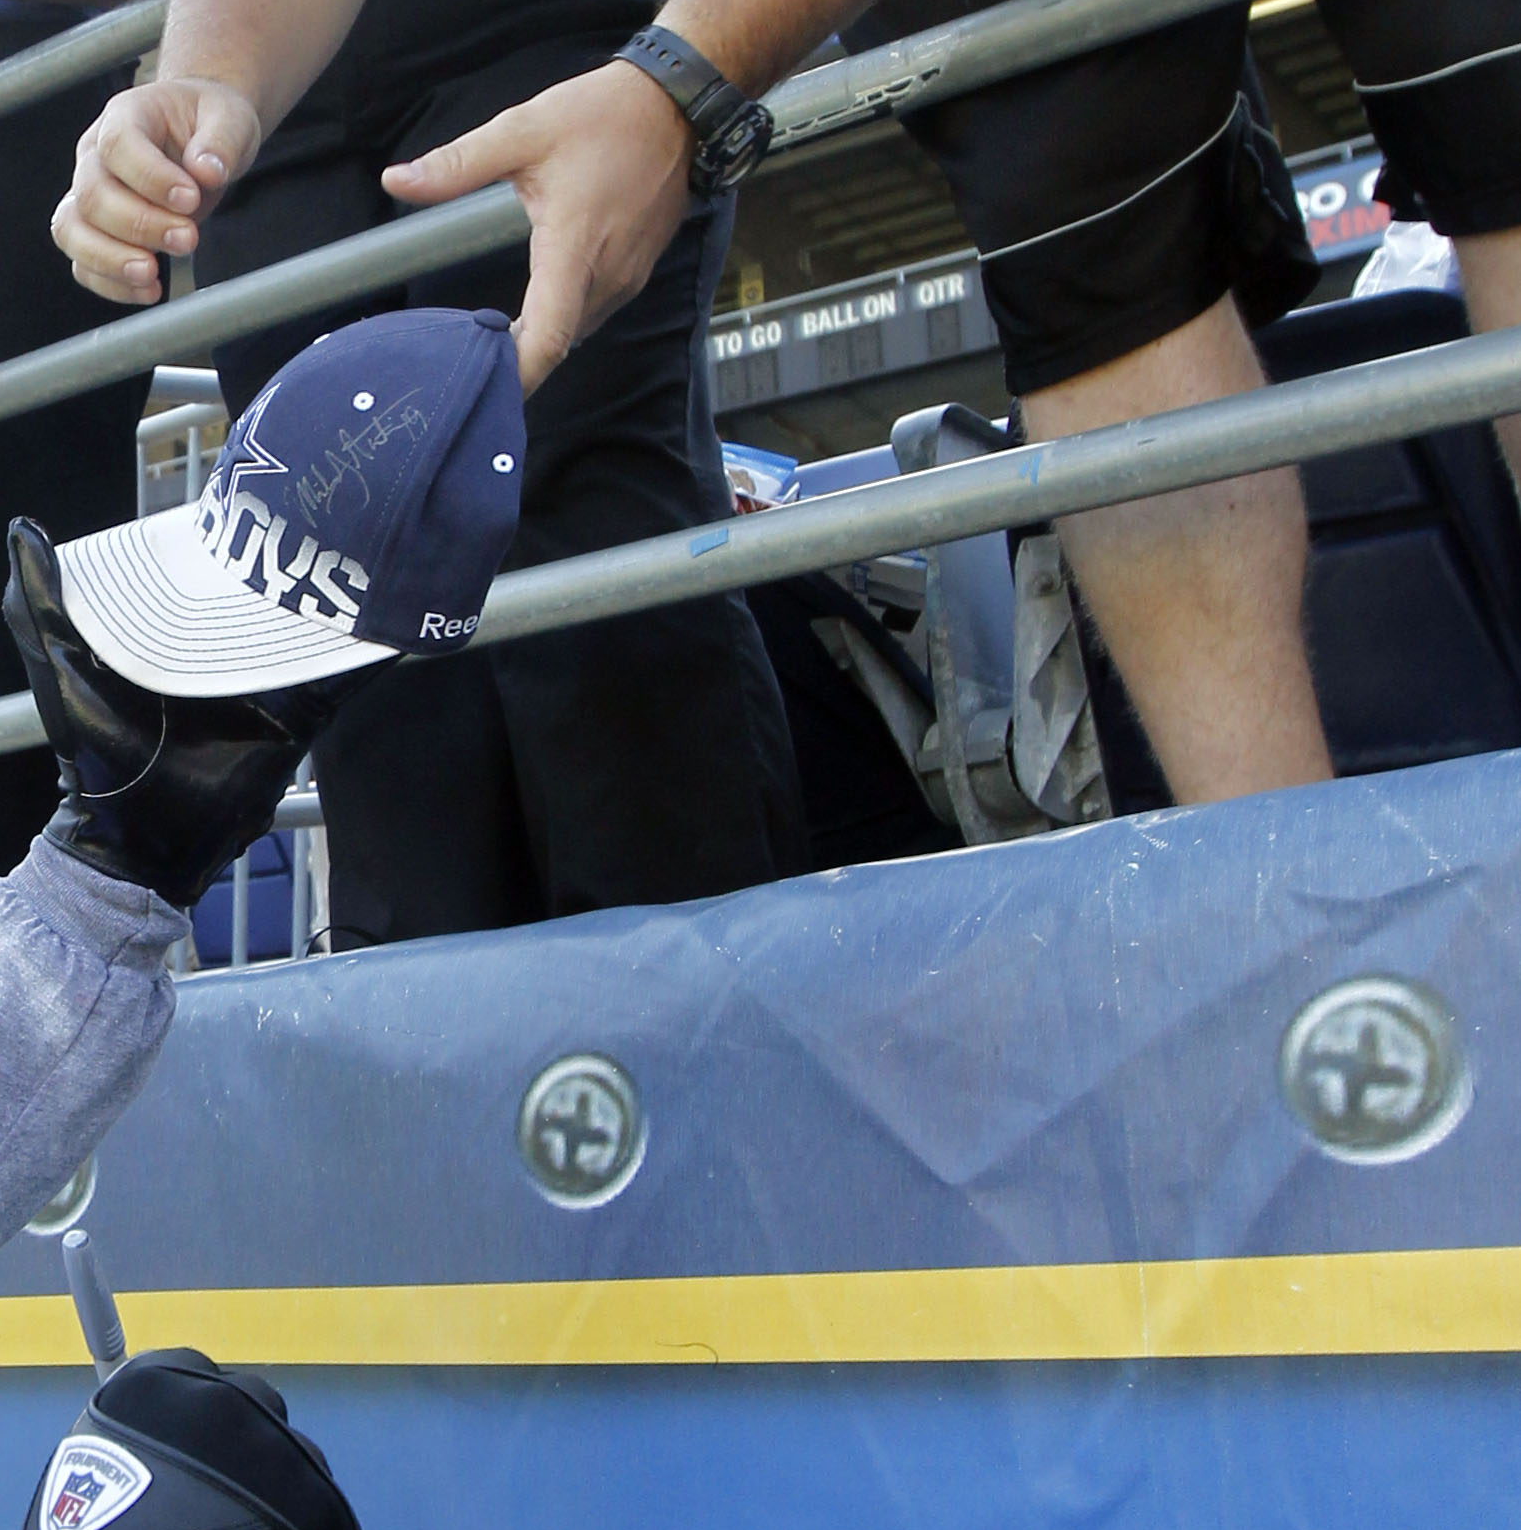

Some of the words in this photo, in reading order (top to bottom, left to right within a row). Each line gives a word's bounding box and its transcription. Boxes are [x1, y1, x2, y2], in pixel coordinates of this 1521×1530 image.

[801, 302, 861, 338] BALL
[862, 289, 897, 319] ON
[713, 331, 743, 360] TO
[750, 320, 783, 351] GO
[54, 1491, 87, 1526] NFL
